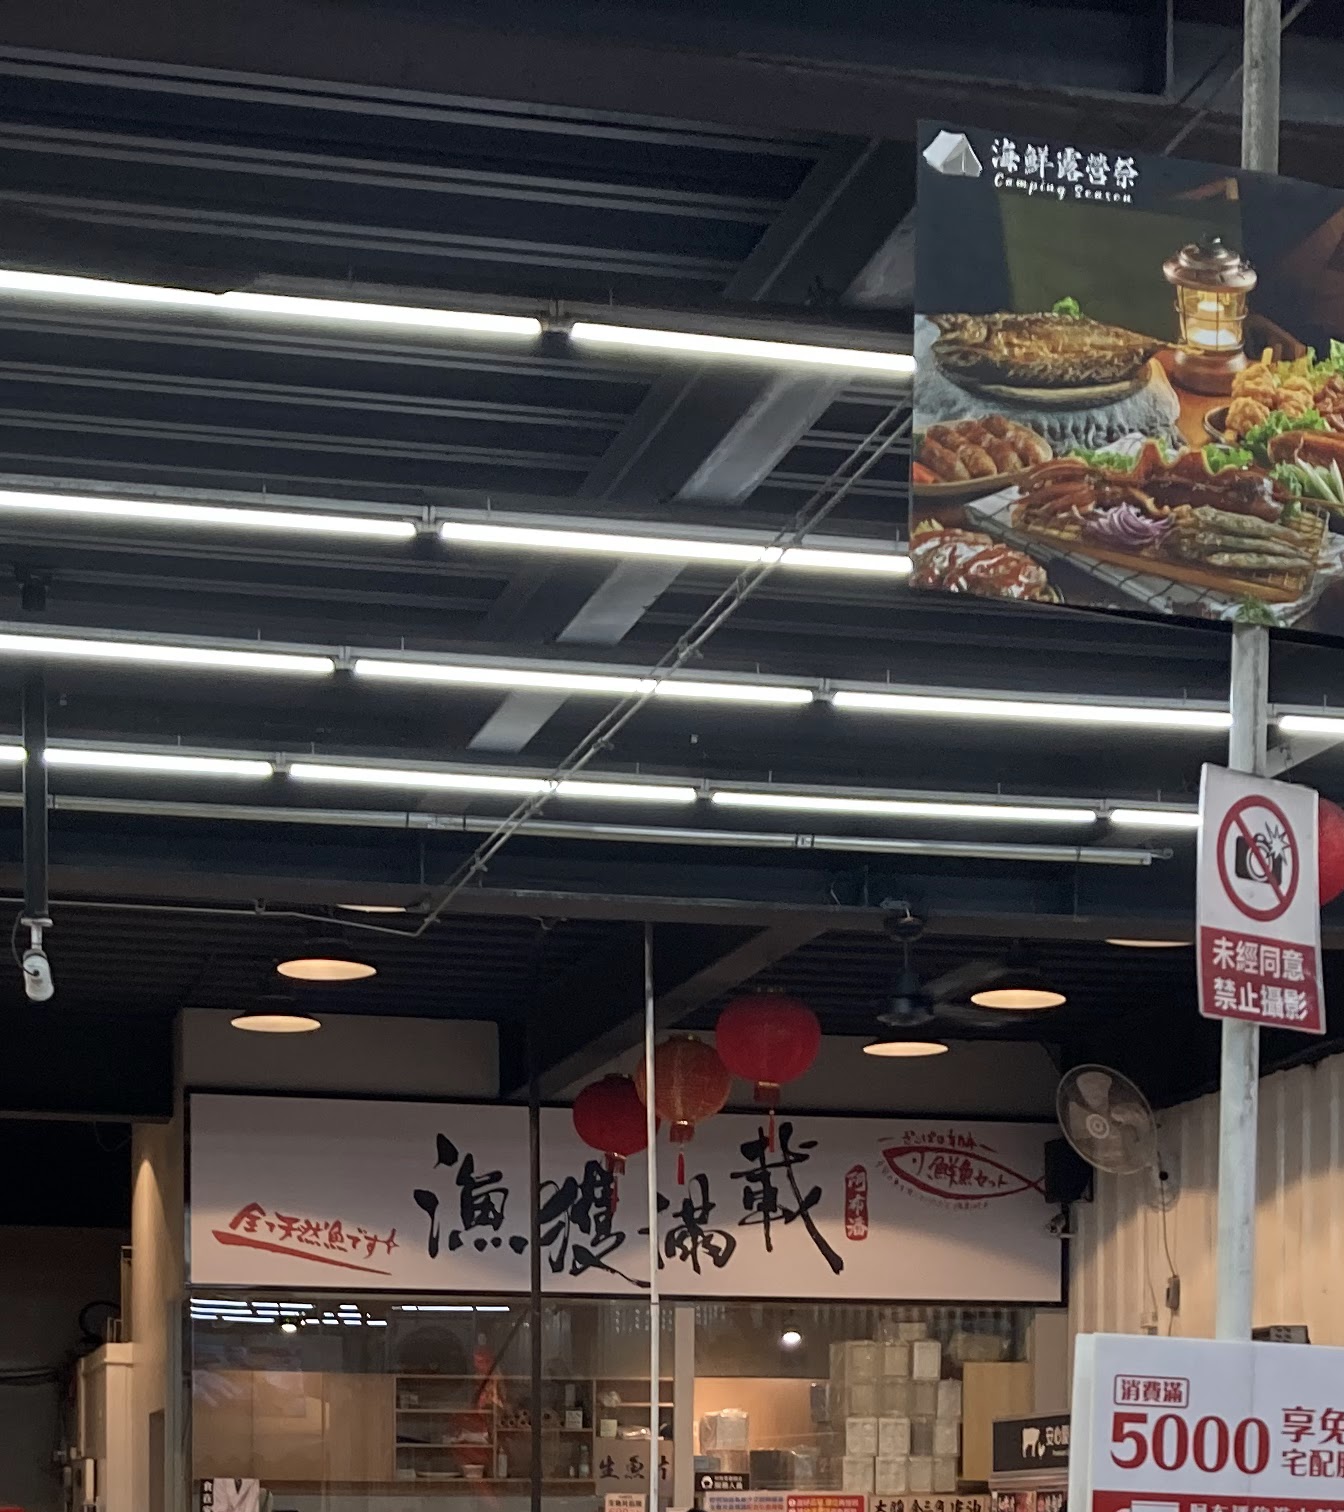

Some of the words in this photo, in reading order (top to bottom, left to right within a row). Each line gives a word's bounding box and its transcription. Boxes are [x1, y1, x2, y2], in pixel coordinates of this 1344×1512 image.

[991, 136, 1139, 189] 海鮮露營祭
[994, 171, 1066, 201] Camping
[1212, 936, 1306, 982] 未經同意
[1213, 976, 1308, 1021] 禁止攝影
[1120, 1379, 1183, 1404] 消費滿
[1110, 1410, 1271, 1475] 5000
